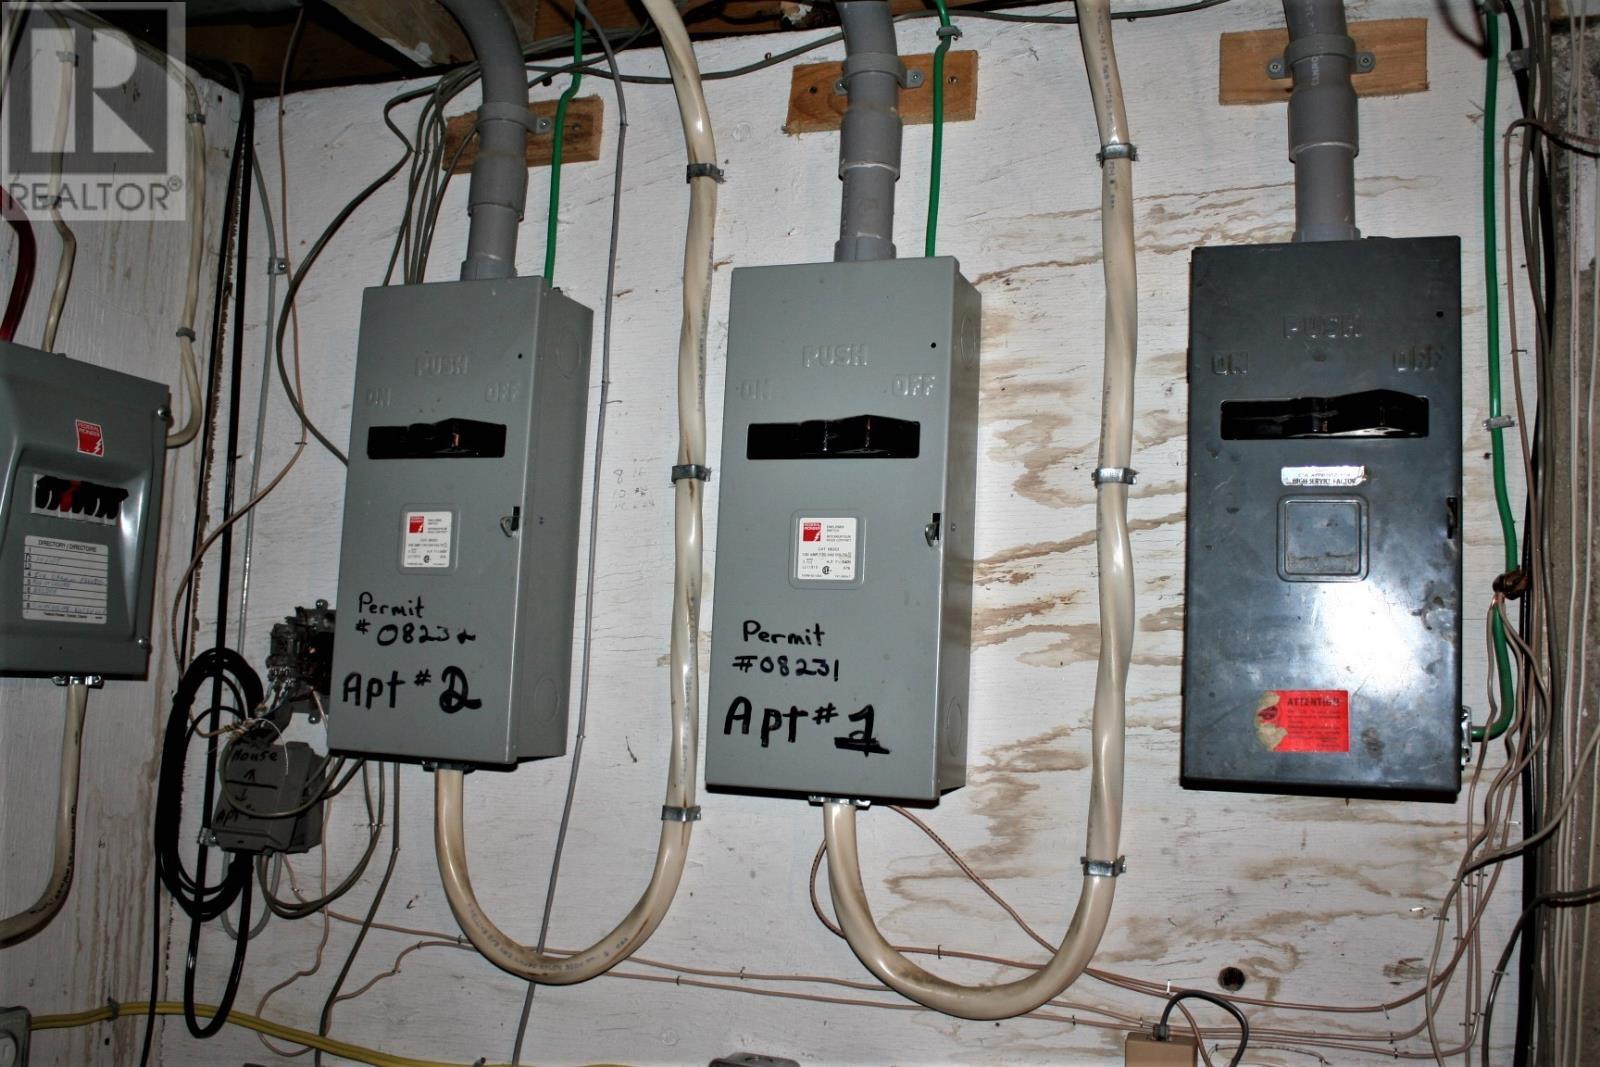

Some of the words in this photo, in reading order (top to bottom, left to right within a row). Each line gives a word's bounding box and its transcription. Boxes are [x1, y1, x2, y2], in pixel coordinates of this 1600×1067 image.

[1282, 314, 1361, 339] PUSH
[416, 353, 469, 377] PUSH
[803, 344, 868, 367] PUSH
[1211, 352, 1248, 376] ON
[892, 373, 937, 397] OFF
[359, 591, 425, 618] Permit
[743, 620, 826, 646] Permit
[732, 655, 839, 682] #08231
[343, 670, 406, 710] Apt
[723, 695, 809, 748] Apt
